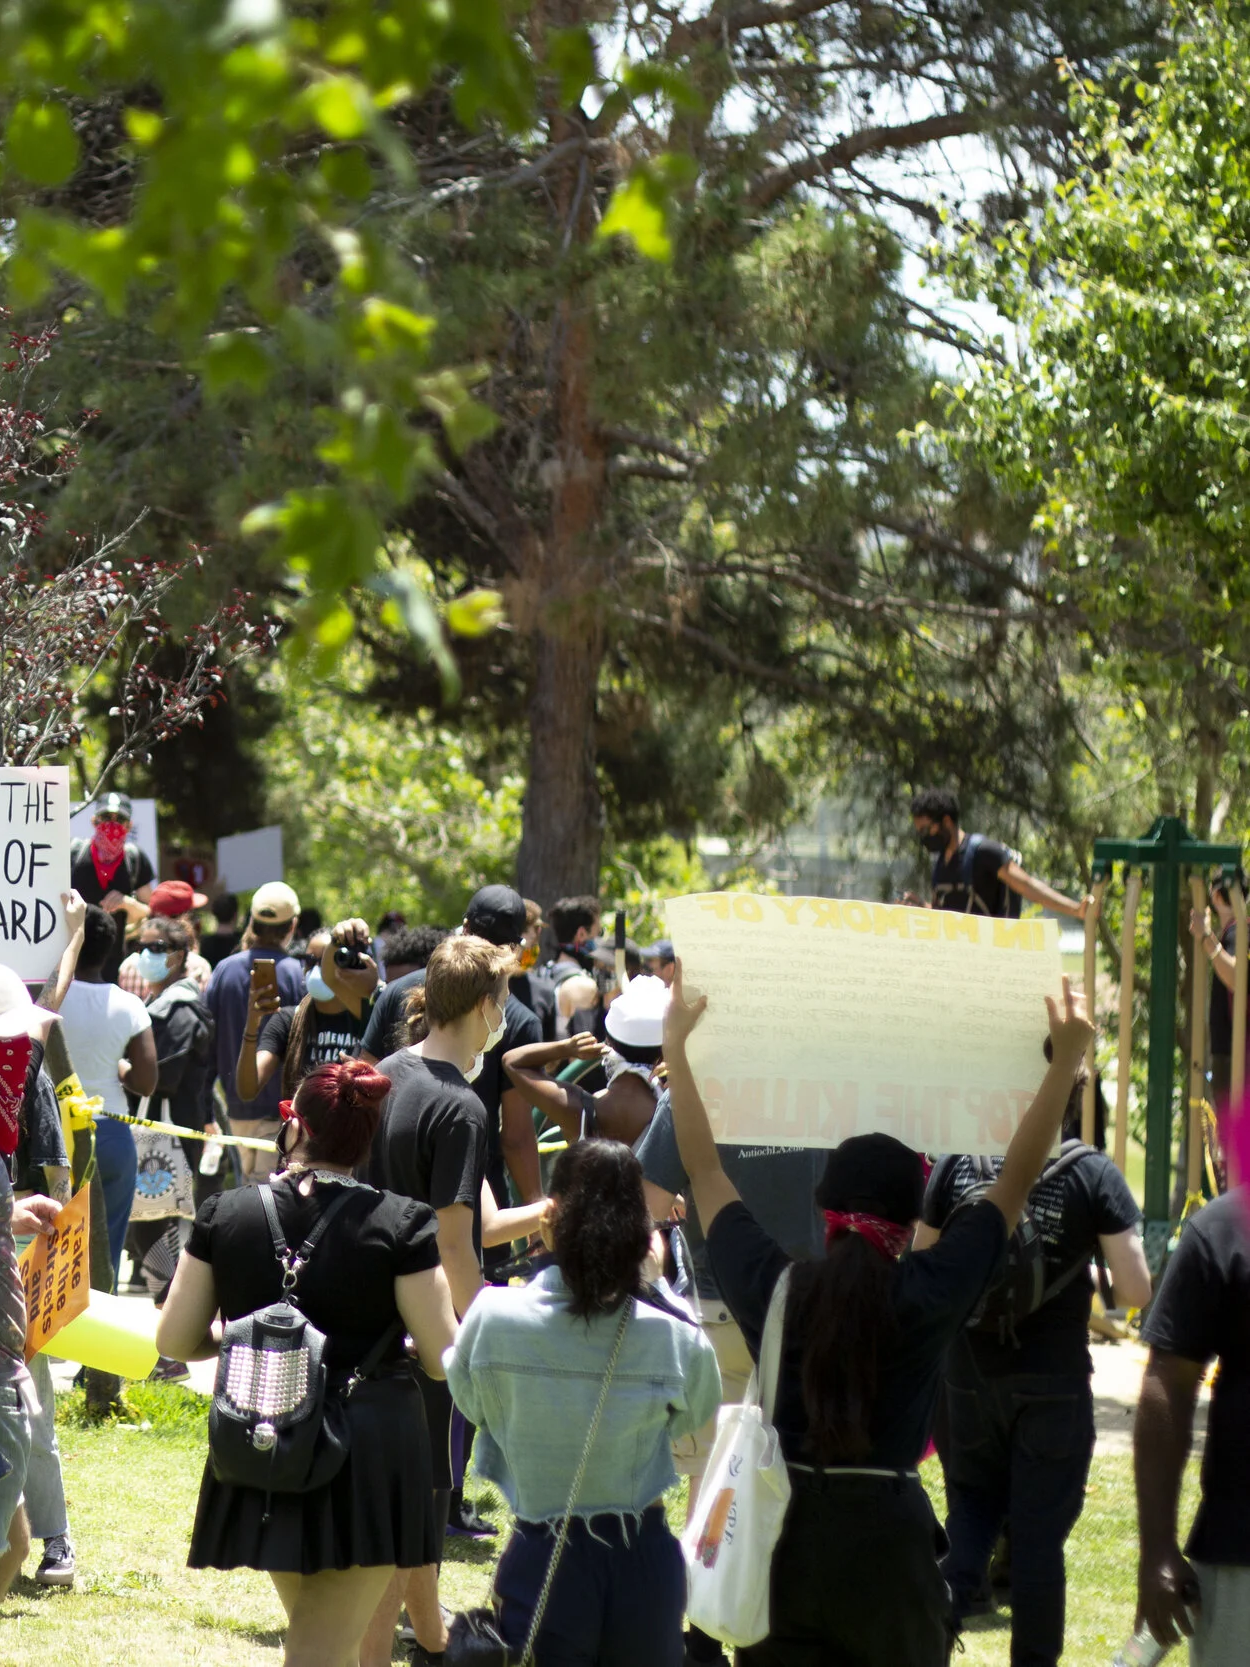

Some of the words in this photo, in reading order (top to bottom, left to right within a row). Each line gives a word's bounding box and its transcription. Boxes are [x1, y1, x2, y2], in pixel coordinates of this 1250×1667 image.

[0, 781, 59, 825] THE
[3, 839, 52, 888] OF
[60, 1224, 73, 1256] to
[70, 1216, 85, 1290] Take
[29, 1269, 42, 1323] and
[42, 1228, 60, 1335] Streets
[56, 1262, 71, 1311] the
